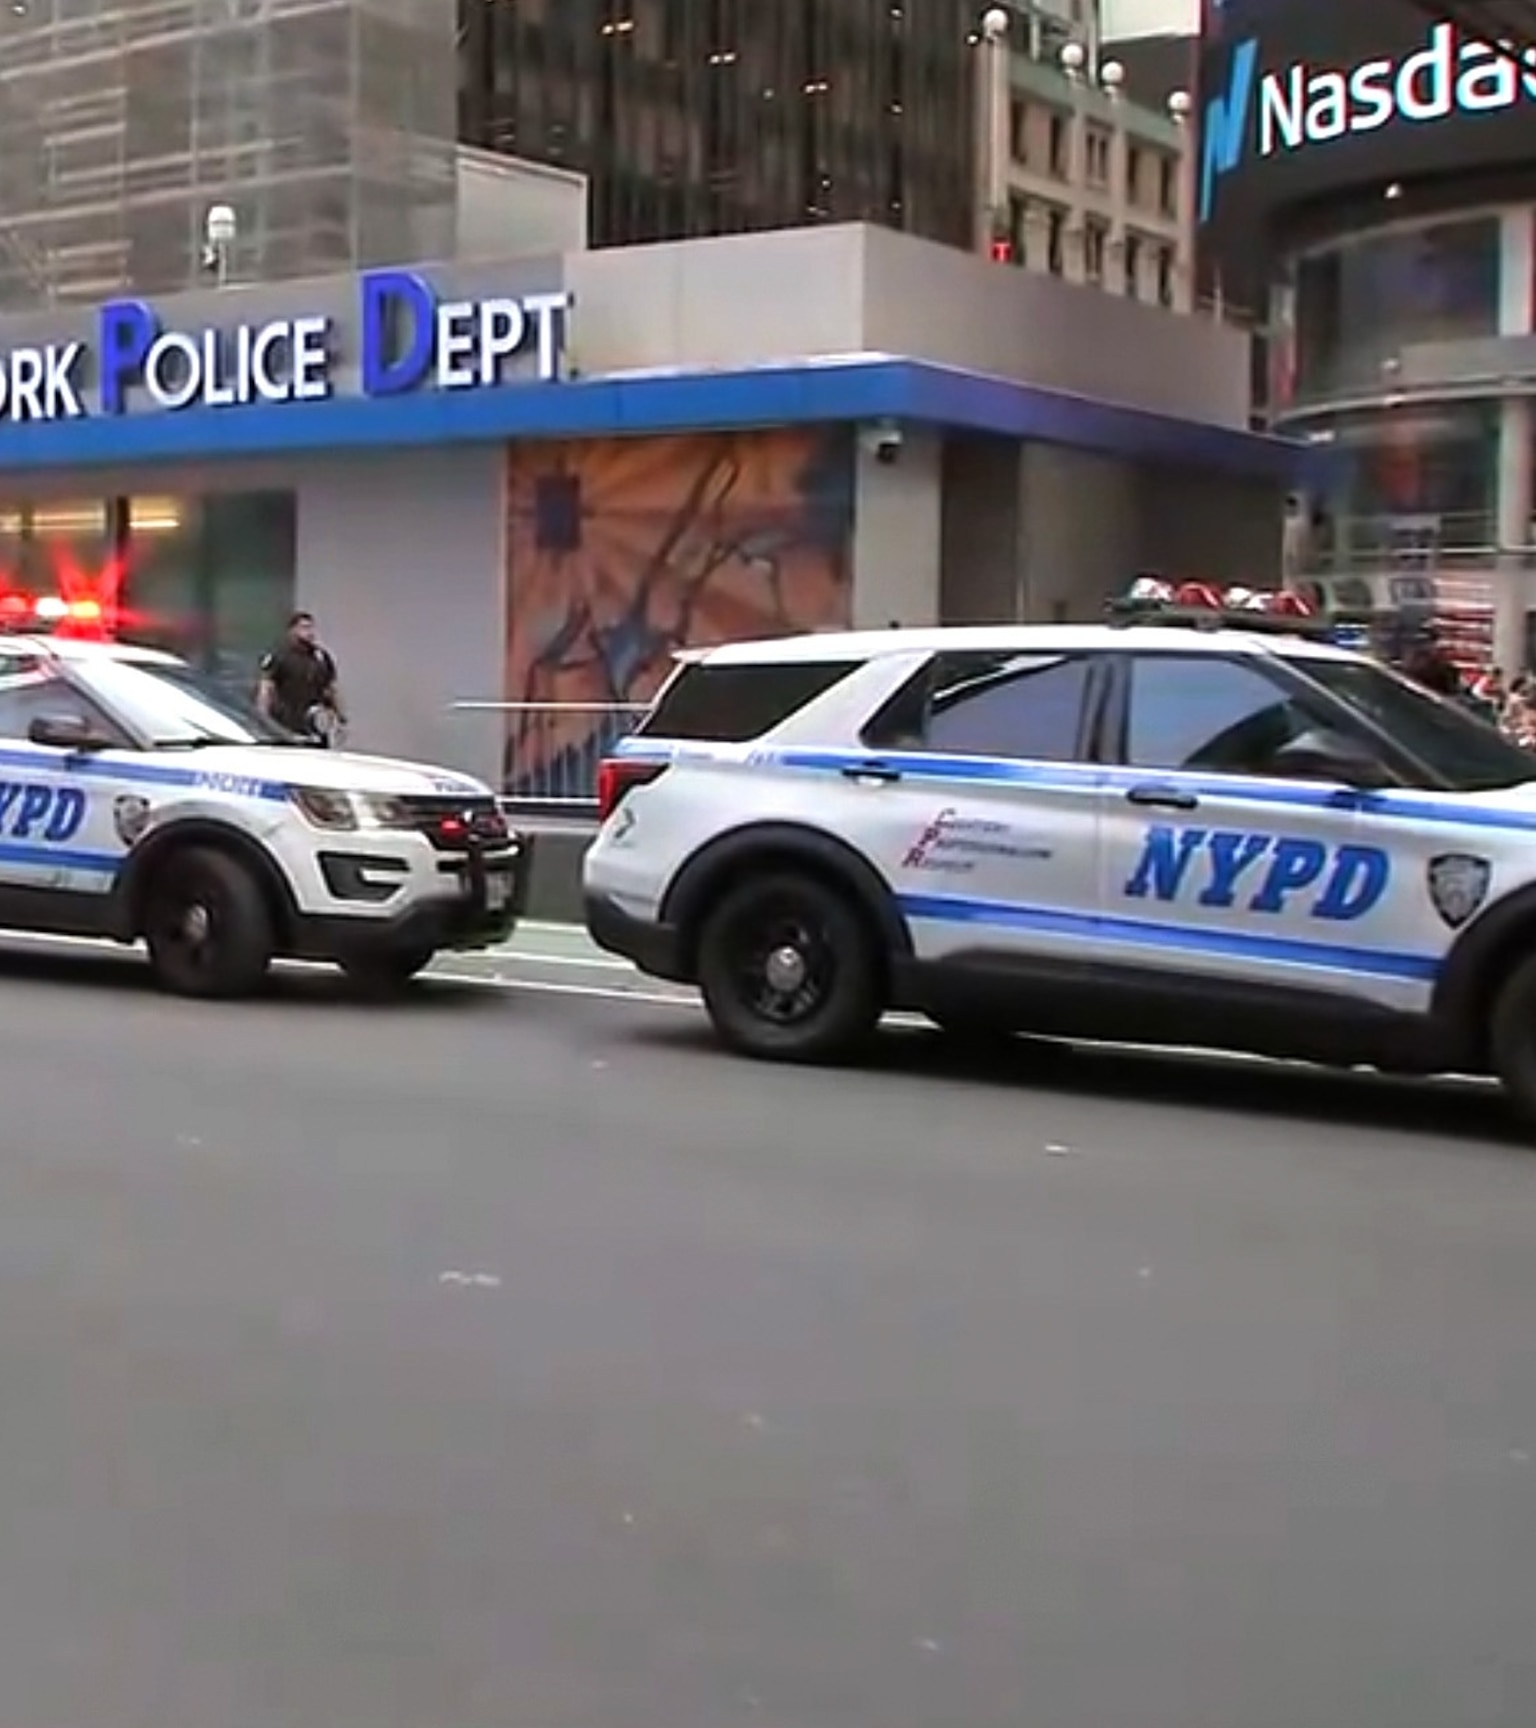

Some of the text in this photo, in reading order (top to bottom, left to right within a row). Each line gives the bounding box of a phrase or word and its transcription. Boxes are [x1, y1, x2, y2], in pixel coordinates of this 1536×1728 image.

[1260, 22, 1536, 155] Nasda
[100, 298, 330, 415] POLICE
[361, 269, 569, 395] DEPT
[1124, 825, 1389, 921] NYPD
